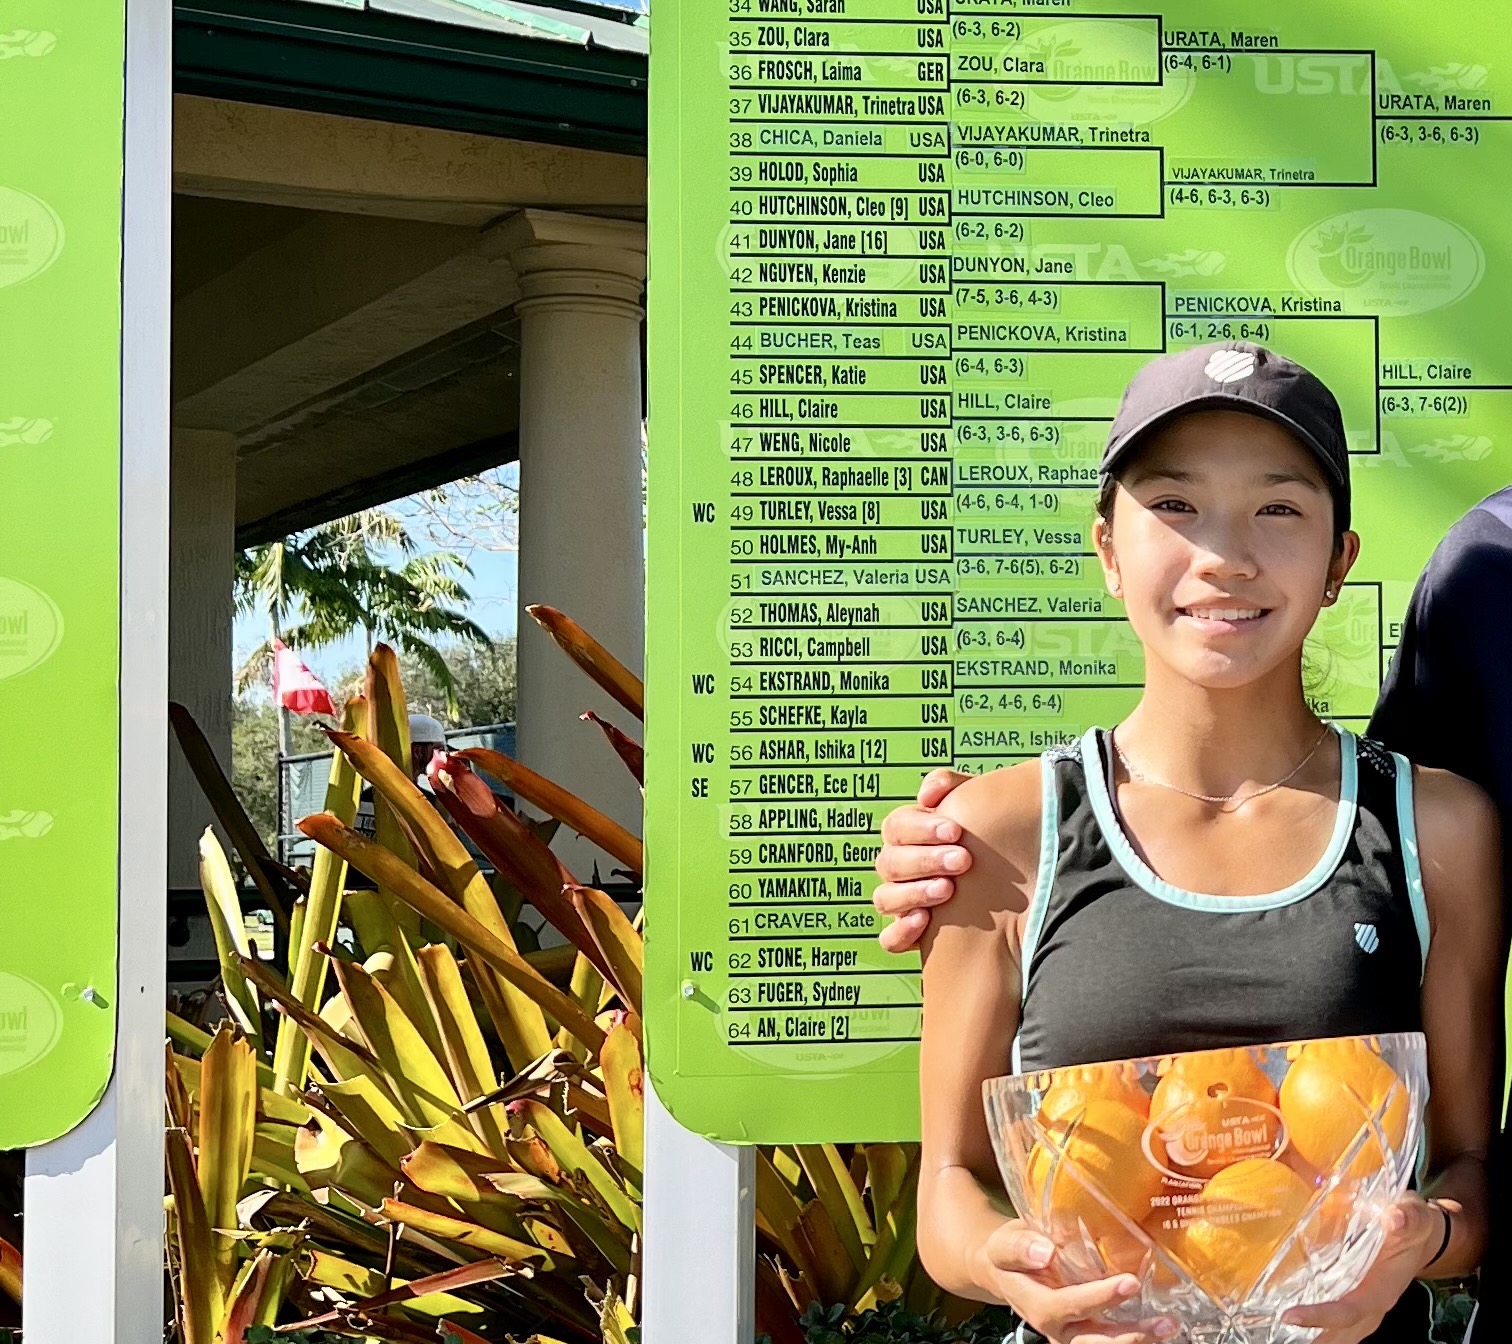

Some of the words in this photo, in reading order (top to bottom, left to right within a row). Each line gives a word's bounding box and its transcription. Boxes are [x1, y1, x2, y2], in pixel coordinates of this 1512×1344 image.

[729, 65, 752, 80] 36
[758, 61, 818, 83] FROSCH,
[822, 63, 862, 81] Laima
[918, 62, 944, 82] GER
[730, 200, 753, 215] 40
[759, 197, 852, 219] HUTCHINSON,
[856, 198, 886, 217] Cleo
[890, 198, 908, 221] [9]
[919, 197, 945, 217] USA
[1382, 364, 1423, 383] HILL,
[1427, 364, 1471, 379] Claire
[1382, 395, 1415, 414] (6-3,
[1420, 395, 1467, 414] 7-6(2))
[730, 471, 753, 487] 48
[760, 467, 817, 489] LEROUX,
[822, 468, 889, 489] Raphaelle
[894, 470, 912, 492] [3]
[921, 467, 948, 486] CAN
[692, 743, 714, 763] WC
[730, 745, 753, 761] 56
[759, 740, 811, 762] ASHAR,
[814, 740, 855, 760] Ishika
[860, 740, 887, 763] [12]
[921, 738, 948, 758] USA
[729, 884, 752, 899] 60
[759, 878, 832, 900] YAMAKITA,
[837, 877, 862, 897] Mia
[691, 951, 713, 972] WC
[729, 954, 751, 969] 62
[758, 948, 807, 971] STONE,
[812, 947, 857, 972] Harper
[729, 1024, 751, 1038] 64
[758, 1017, 781, 1041] AN,
[785, 1017, 825, 1037] Claire
[832, 1017, 849, 1040] [2]
